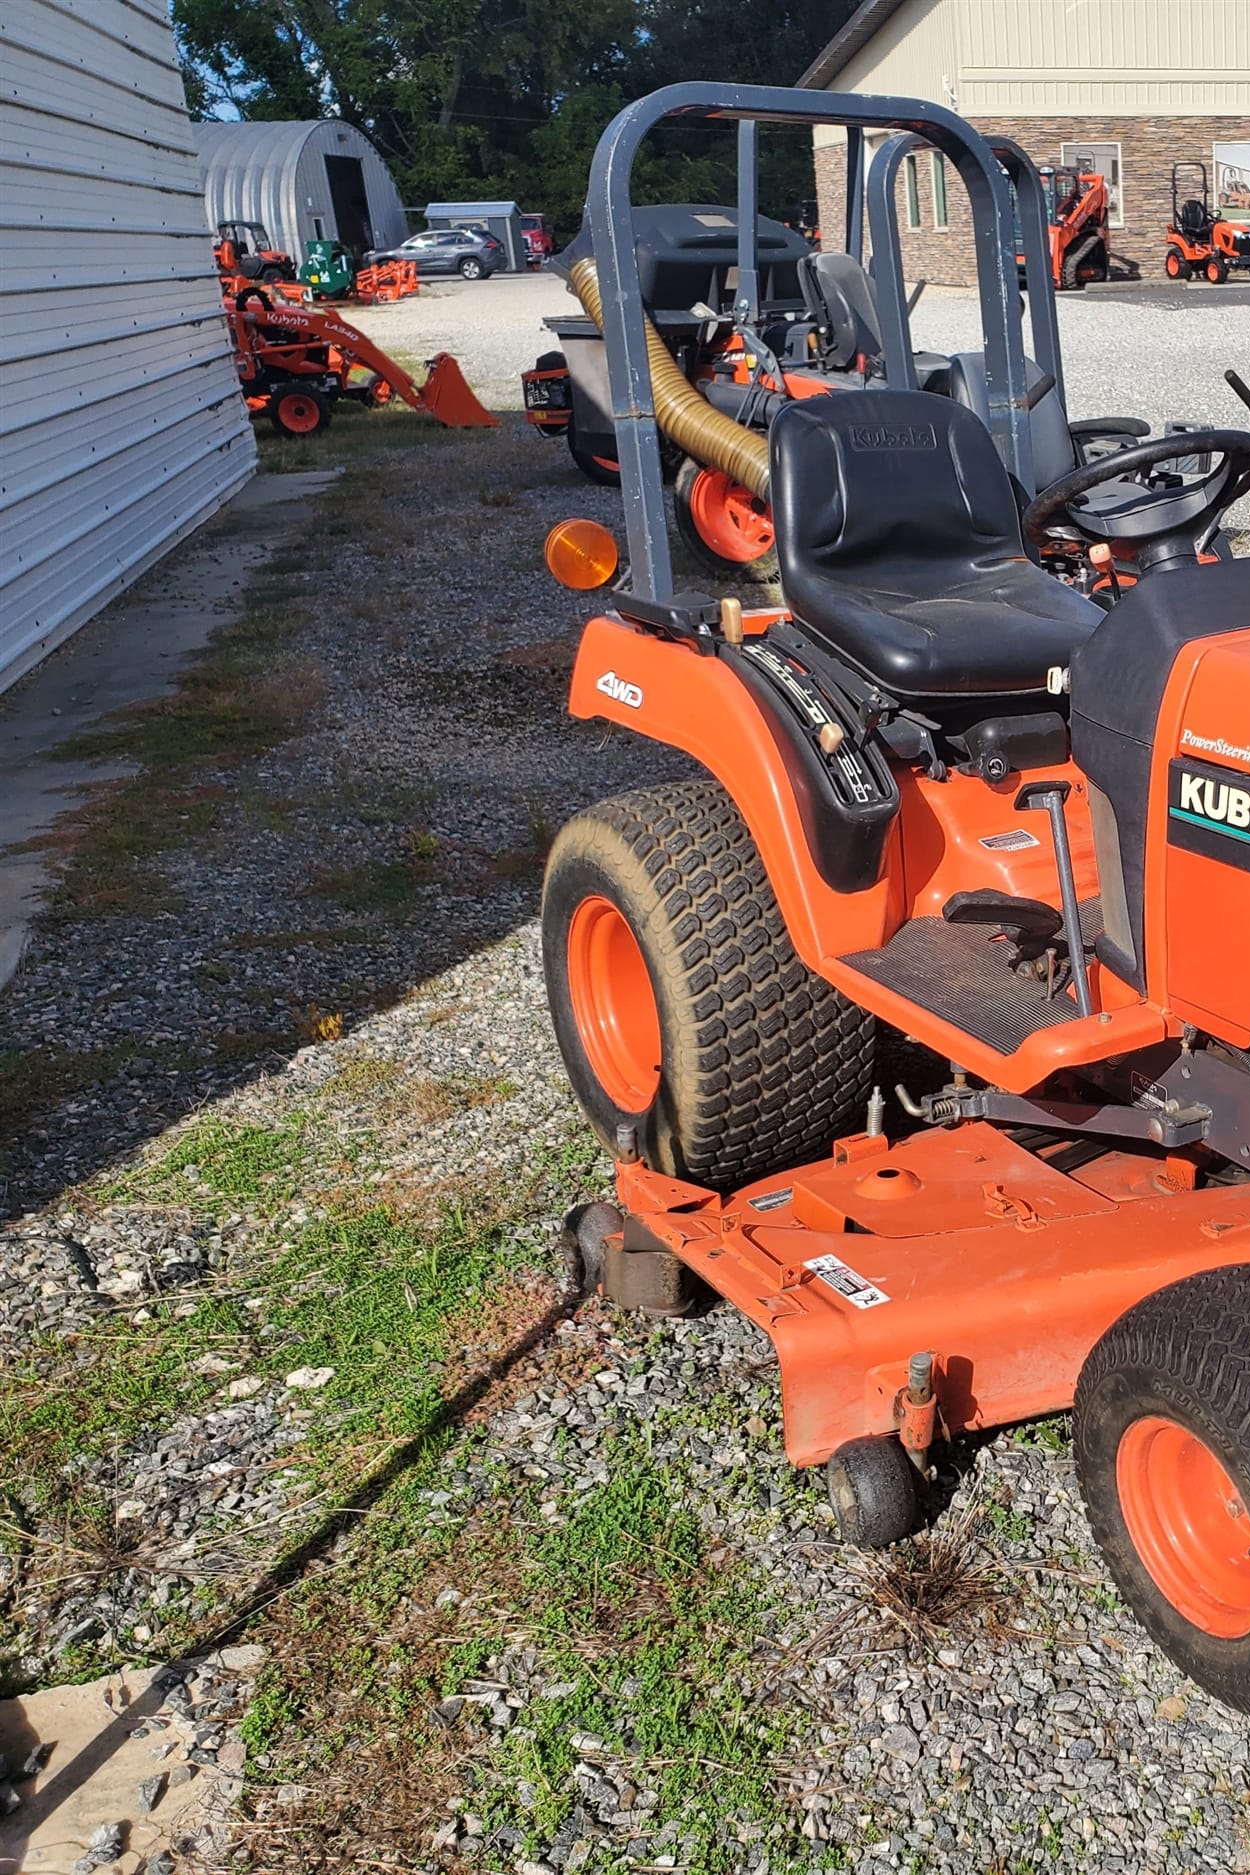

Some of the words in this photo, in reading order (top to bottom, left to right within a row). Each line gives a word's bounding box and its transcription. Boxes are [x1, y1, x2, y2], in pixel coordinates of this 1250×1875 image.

[266, 312, 309, 327] Kubota
[851, 426, 931, 448] Kubota
[596, 669, 643, 709] 4WD
[1153, 1378, 1232, 1451] MULTI
